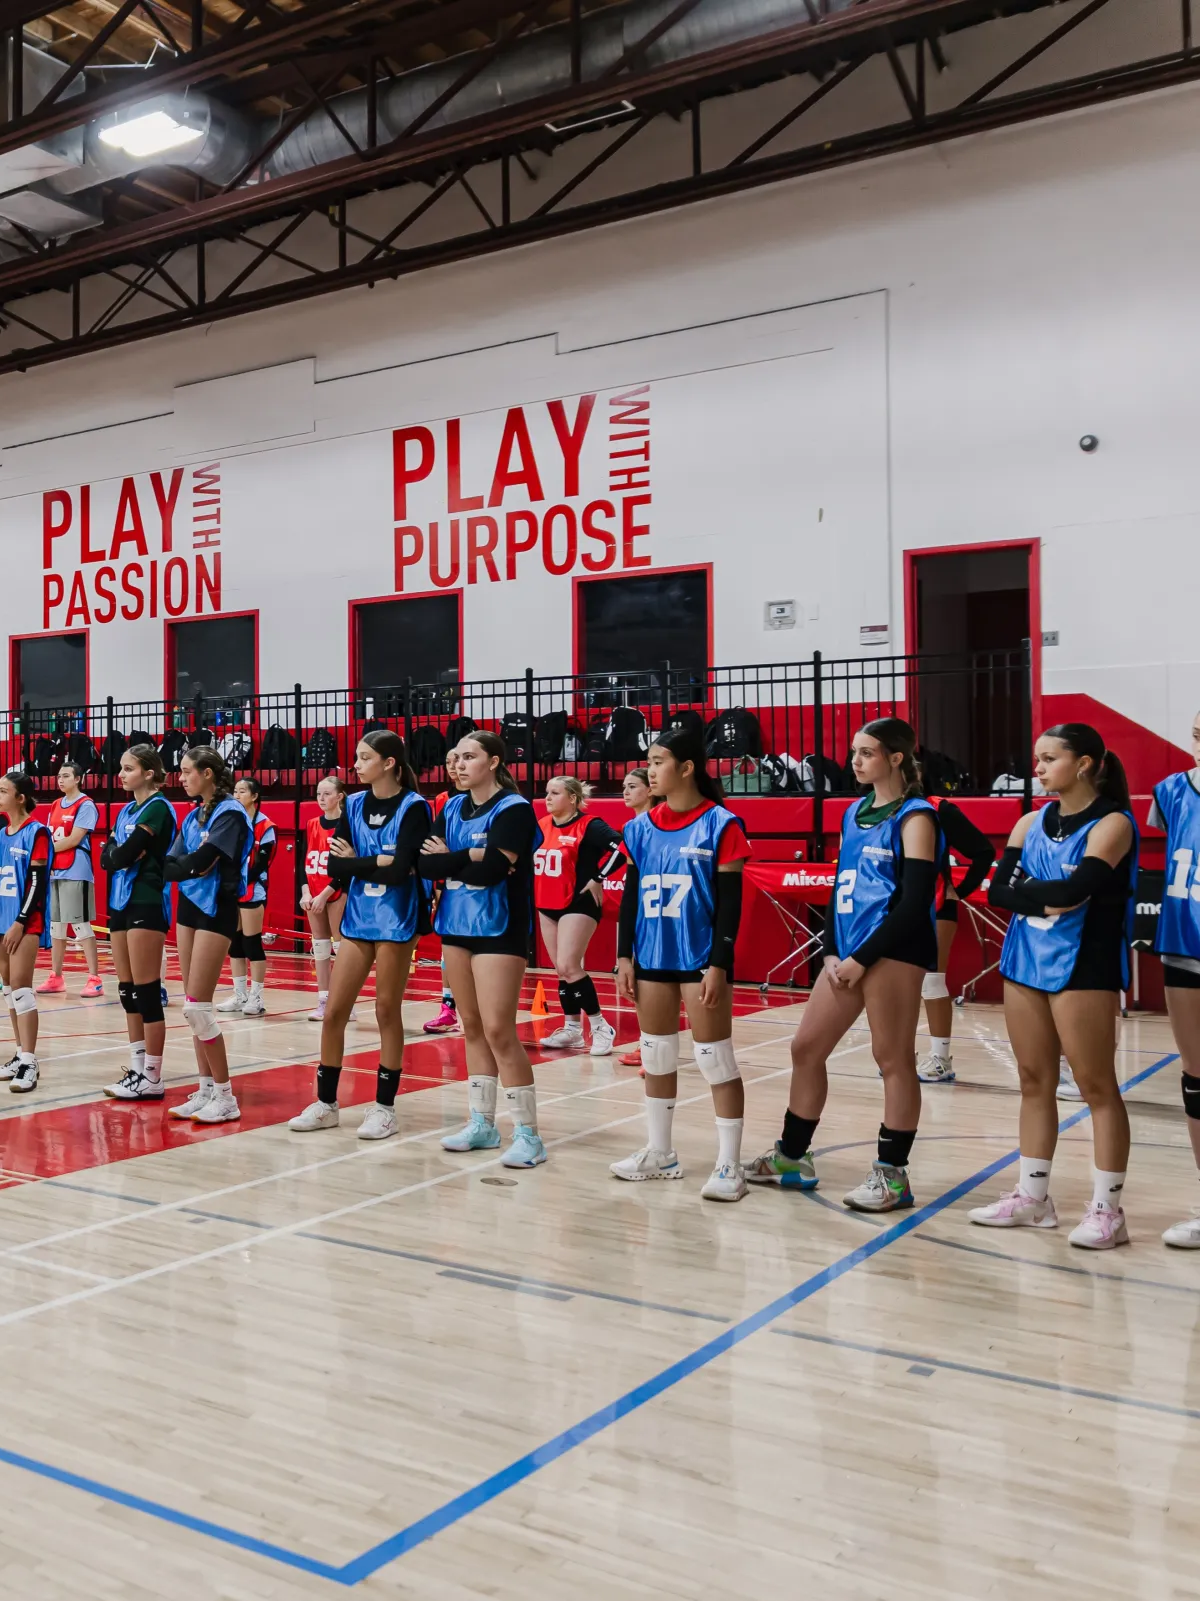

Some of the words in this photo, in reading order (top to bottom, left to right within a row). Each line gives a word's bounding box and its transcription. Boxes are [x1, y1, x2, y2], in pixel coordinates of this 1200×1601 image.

[393, 394, 598, 521] PLAY
[609, 384, 651, 492] WITH
[42, 467, 184, 569] PLAY
[193, 462, 221, 549] WITH
[394, 494, 652, 593] PURPOSE
[43, 552, 222, 629] PASSION
[533, 849, 562, 877] 50
[641, 874, 693, 918] 27
[782, 873, 836, 886] MIKAS
